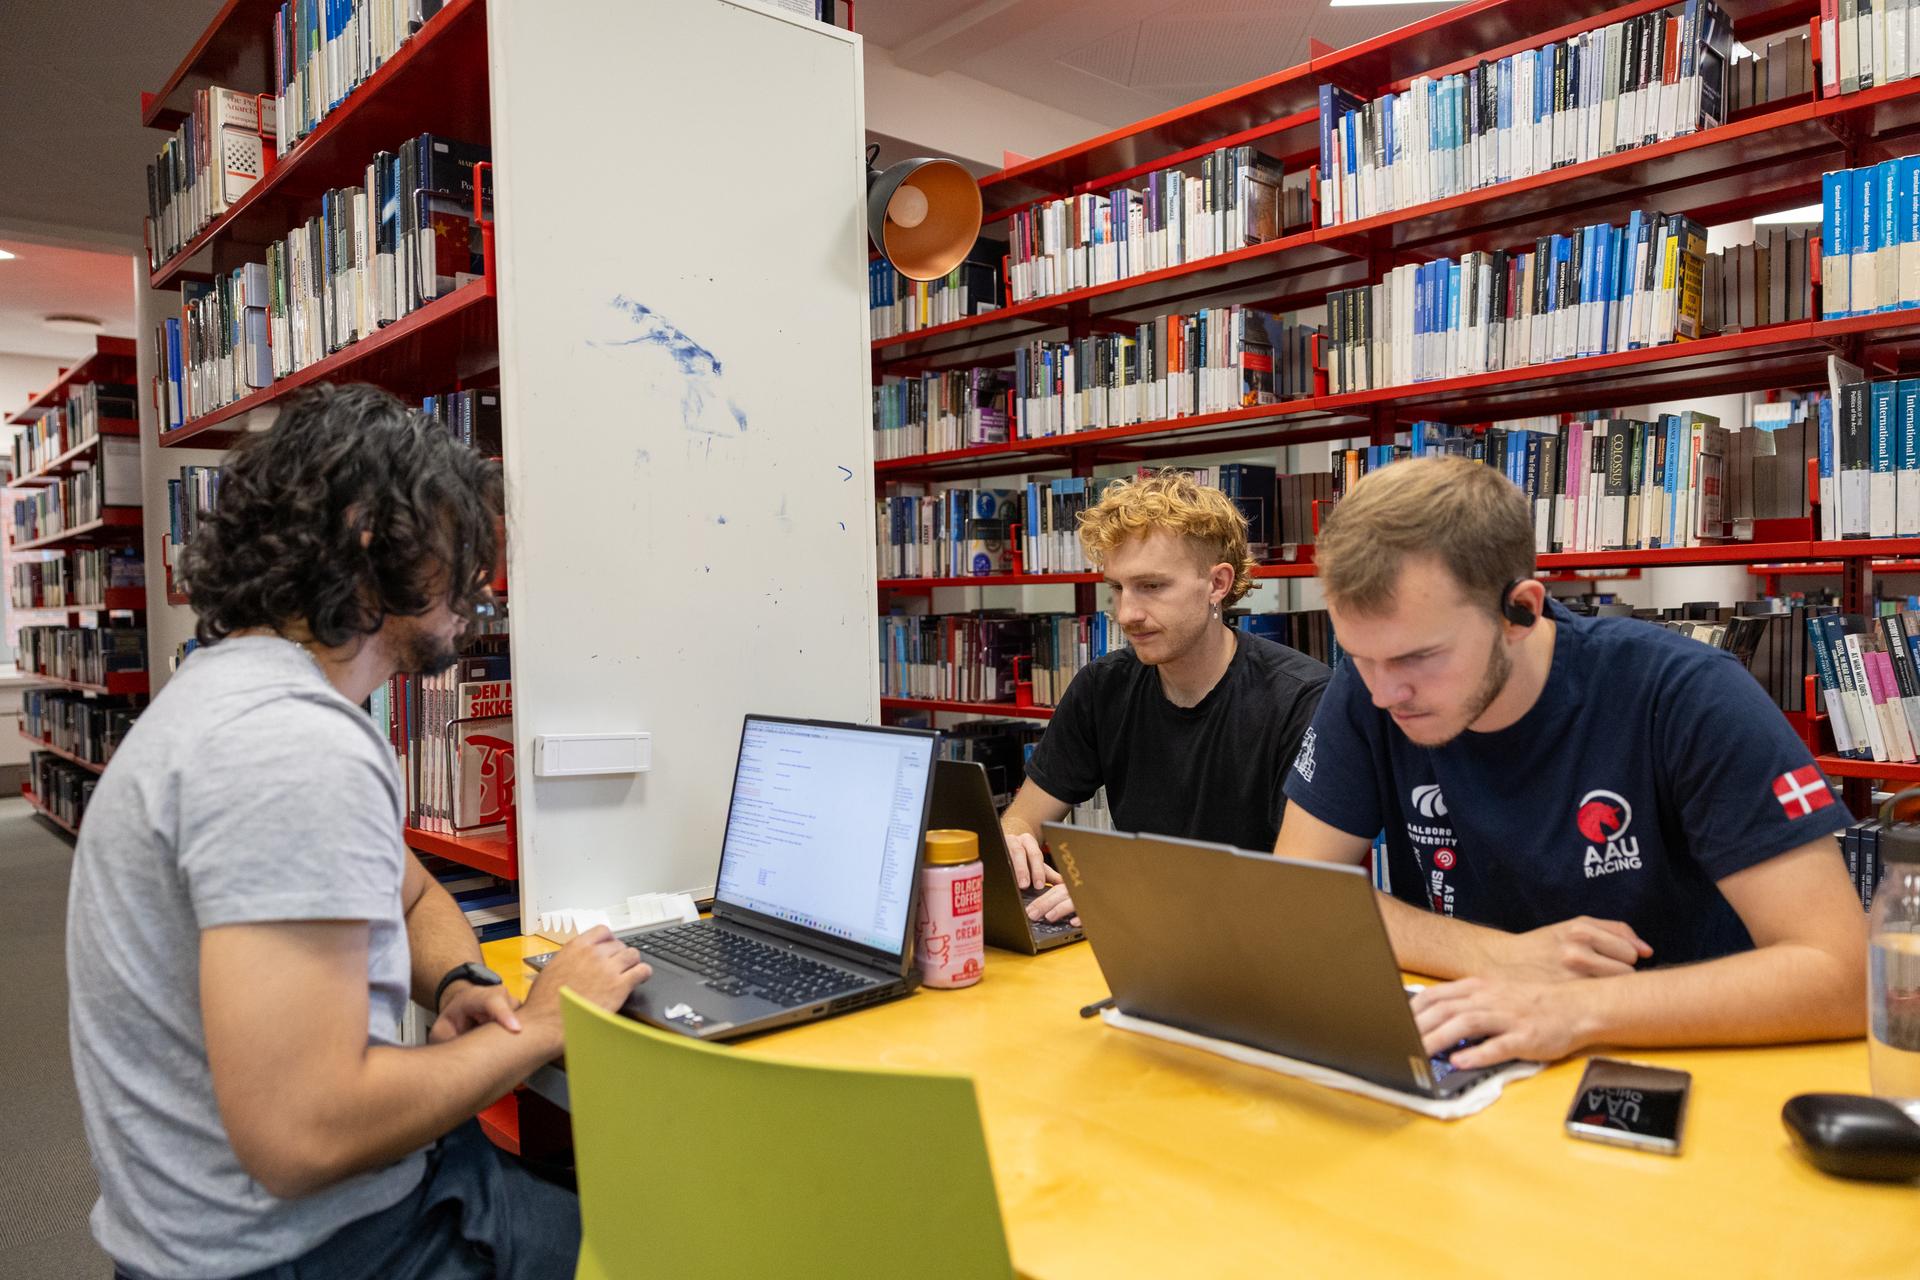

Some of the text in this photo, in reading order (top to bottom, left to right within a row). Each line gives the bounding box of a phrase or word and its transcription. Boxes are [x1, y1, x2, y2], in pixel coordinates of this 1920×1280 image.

[1879, 397, 1889, 457] International
[1906, 395, 1916, 456] International
[1611, 434, 1624, 486] COLOSSUS
[1855, 671, 1864, 683] WITH
[1857, 684, 1867, 696] OURS
[1584, 836, 1640, 866] AAU
[1584, 857, 1642, 879] RACING
[956, 925, 982, 941] CREMA
